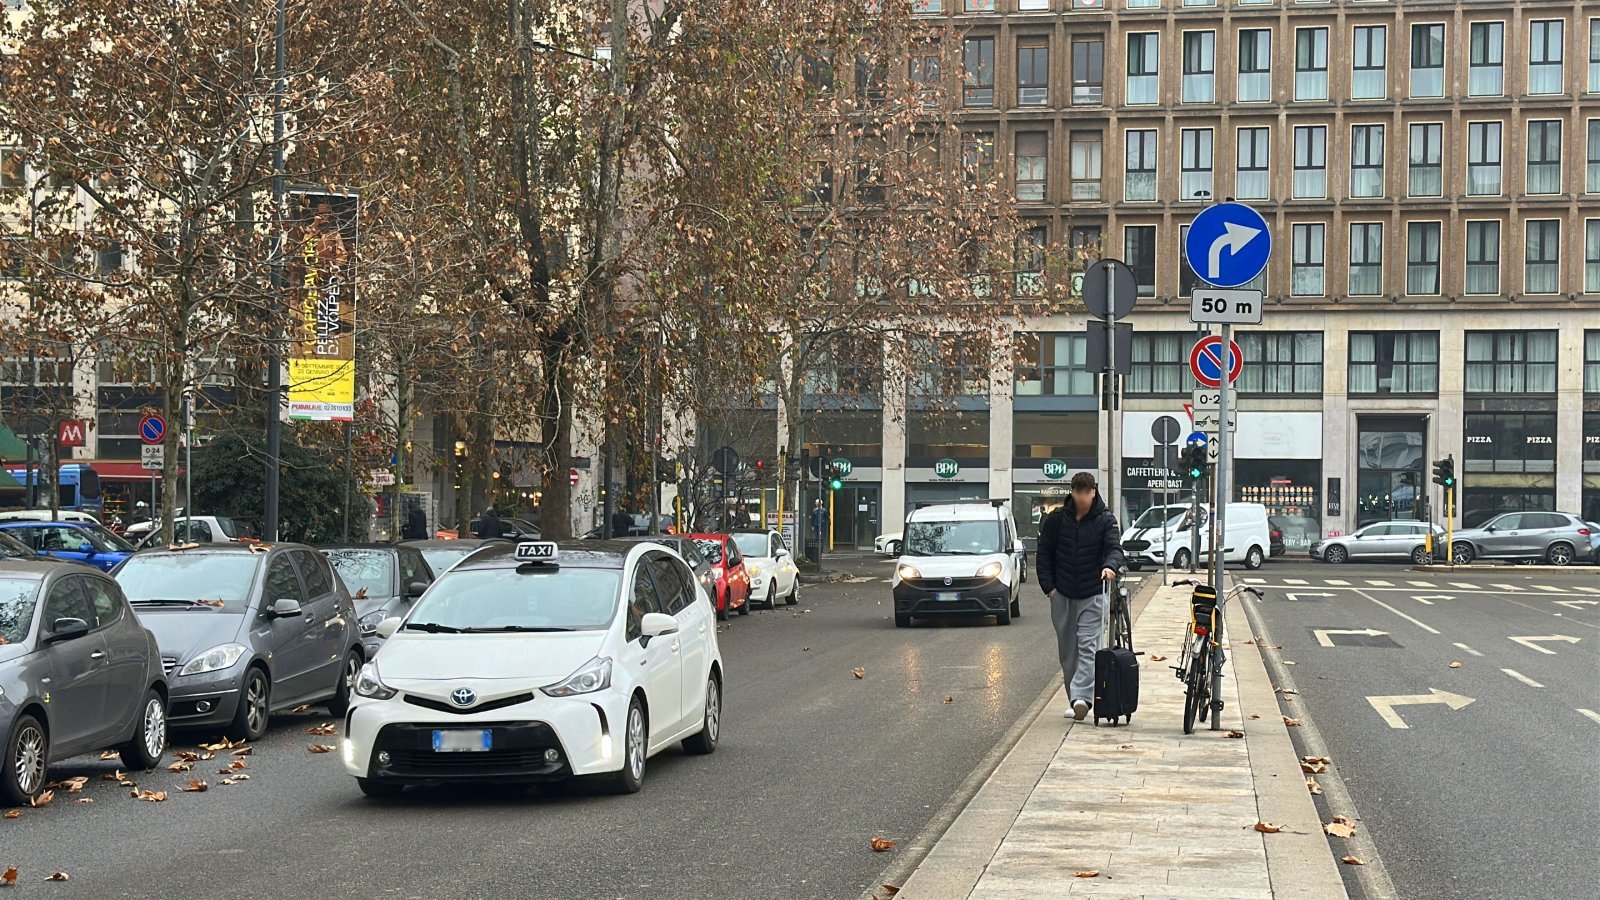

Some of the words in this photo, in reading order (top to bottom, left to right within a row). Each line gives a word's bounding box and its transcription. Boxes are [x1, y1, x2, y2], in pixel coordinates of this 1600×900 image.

[1201, 298, 1227, 313] 50
[1235, 302, 1252, 314] m
[317, 296, 329, 354] PELLIZZ
[1199, 394, 1230, 405] 0-2
[935, 462, 958, 474] BPM
[1043, 463, 1067, 475] BPM
[519, 546, 552, 556] TAXI
